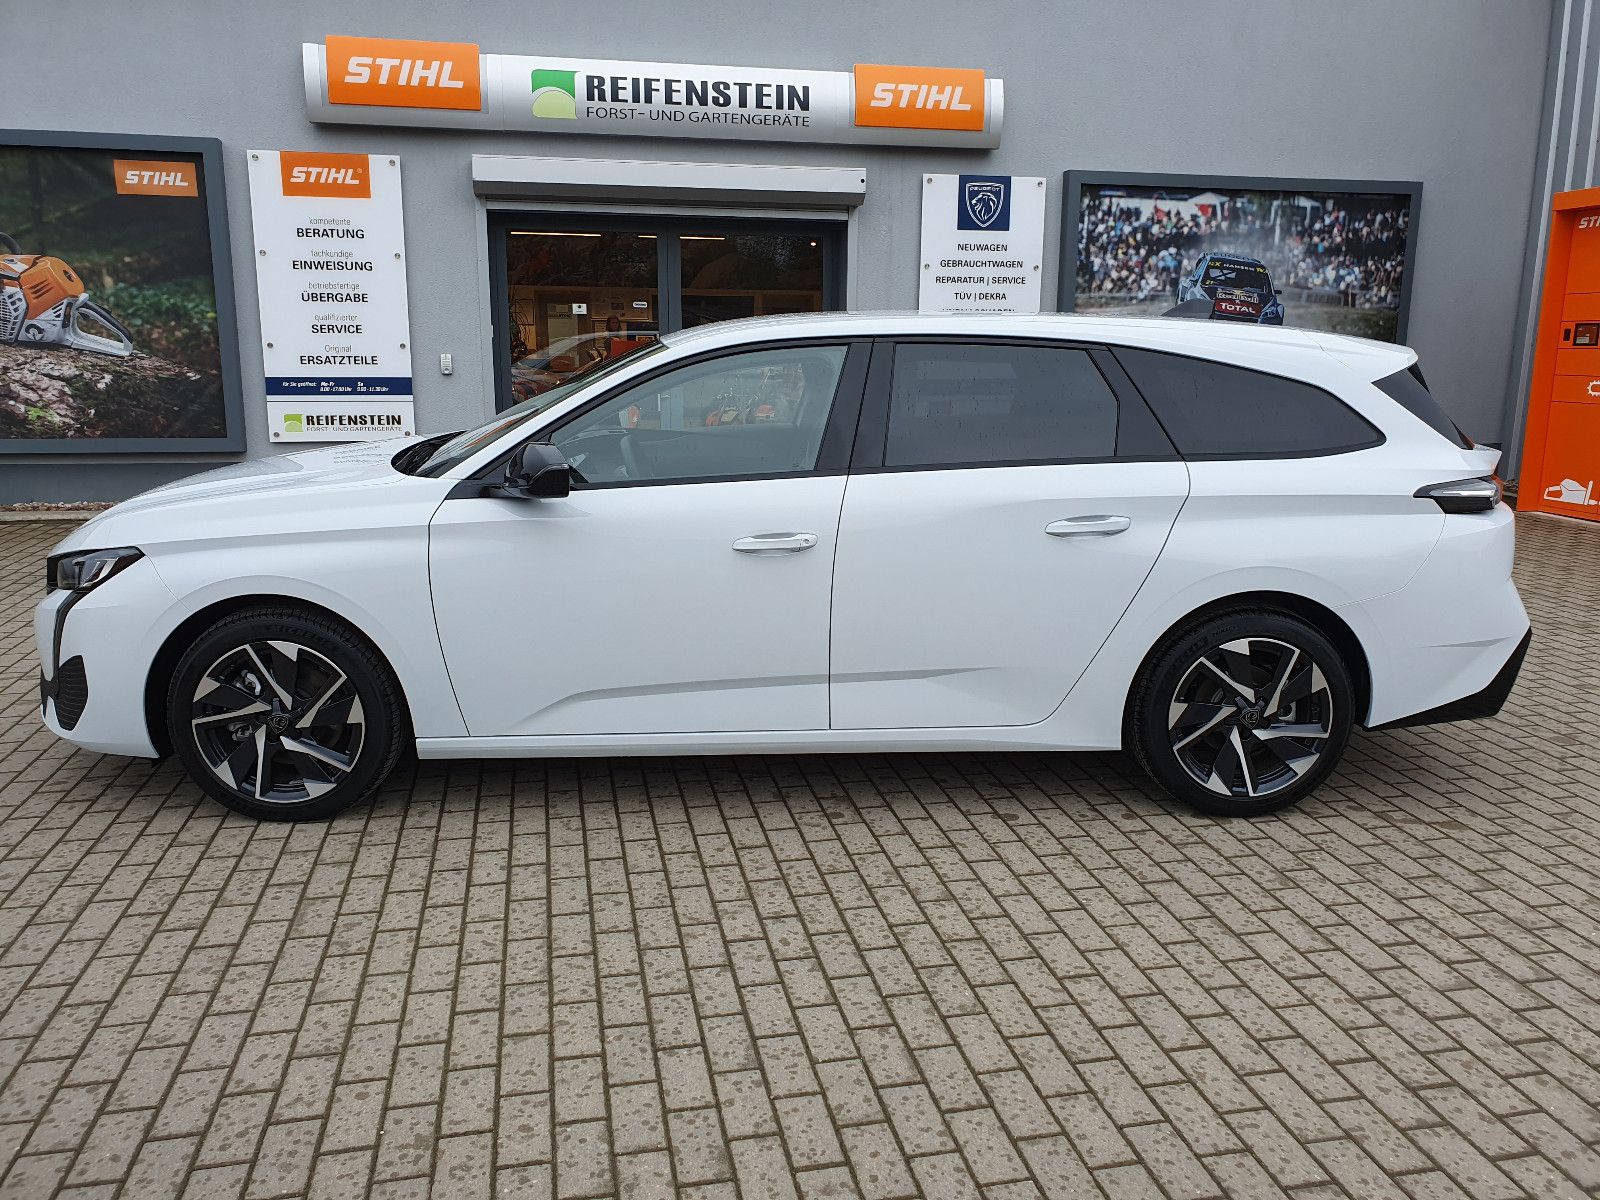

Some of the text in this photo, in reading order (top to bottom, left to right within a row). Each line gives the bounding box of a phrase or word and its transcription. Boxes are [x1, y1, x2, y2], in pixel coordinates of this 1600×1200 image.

[344, 56, 464, 89] STIHL
[585, 74, 810, 112] REIFENSTEIN
[870, 82, 972, 111] STIHL
[586, 106, 810, 128] FORST- UND GARTENGERÄTE
[124, 170, 189, 187] STIHL
[308, 216, 351, 226] kompetente
[296, 227, 365, 239] BERATUNG
[957, 243, 1008, 252] NEUWAGEN
[311, 249, 354, 260] fachkundige
[292, 260, 373, 272] EINWEISUNG
[940, 260, 1023, 268] GEBRAUCHTWAGEN
[308, 281, 360, 291] betriebsfertige
[935, 276, 985, 284] REPARATUR
[991, 277, 1026, 285] SERVICE
[301, 290, 369, 303] ÜBERGABE
[954, 291, 972, 300] TÜV
[978, 292, 1007, 301] DEKRA
[1219, 302, 1257, 314] TOTAL
[314, 313, 358, 323] qualifizierter
[311, 324, 363, 334] SERVICE
[324, 344, 352, 354] Original
[300, 355, 379, 365] ERSATZTEILE
[306, 414, 402, 426] REIFENSTEIN
